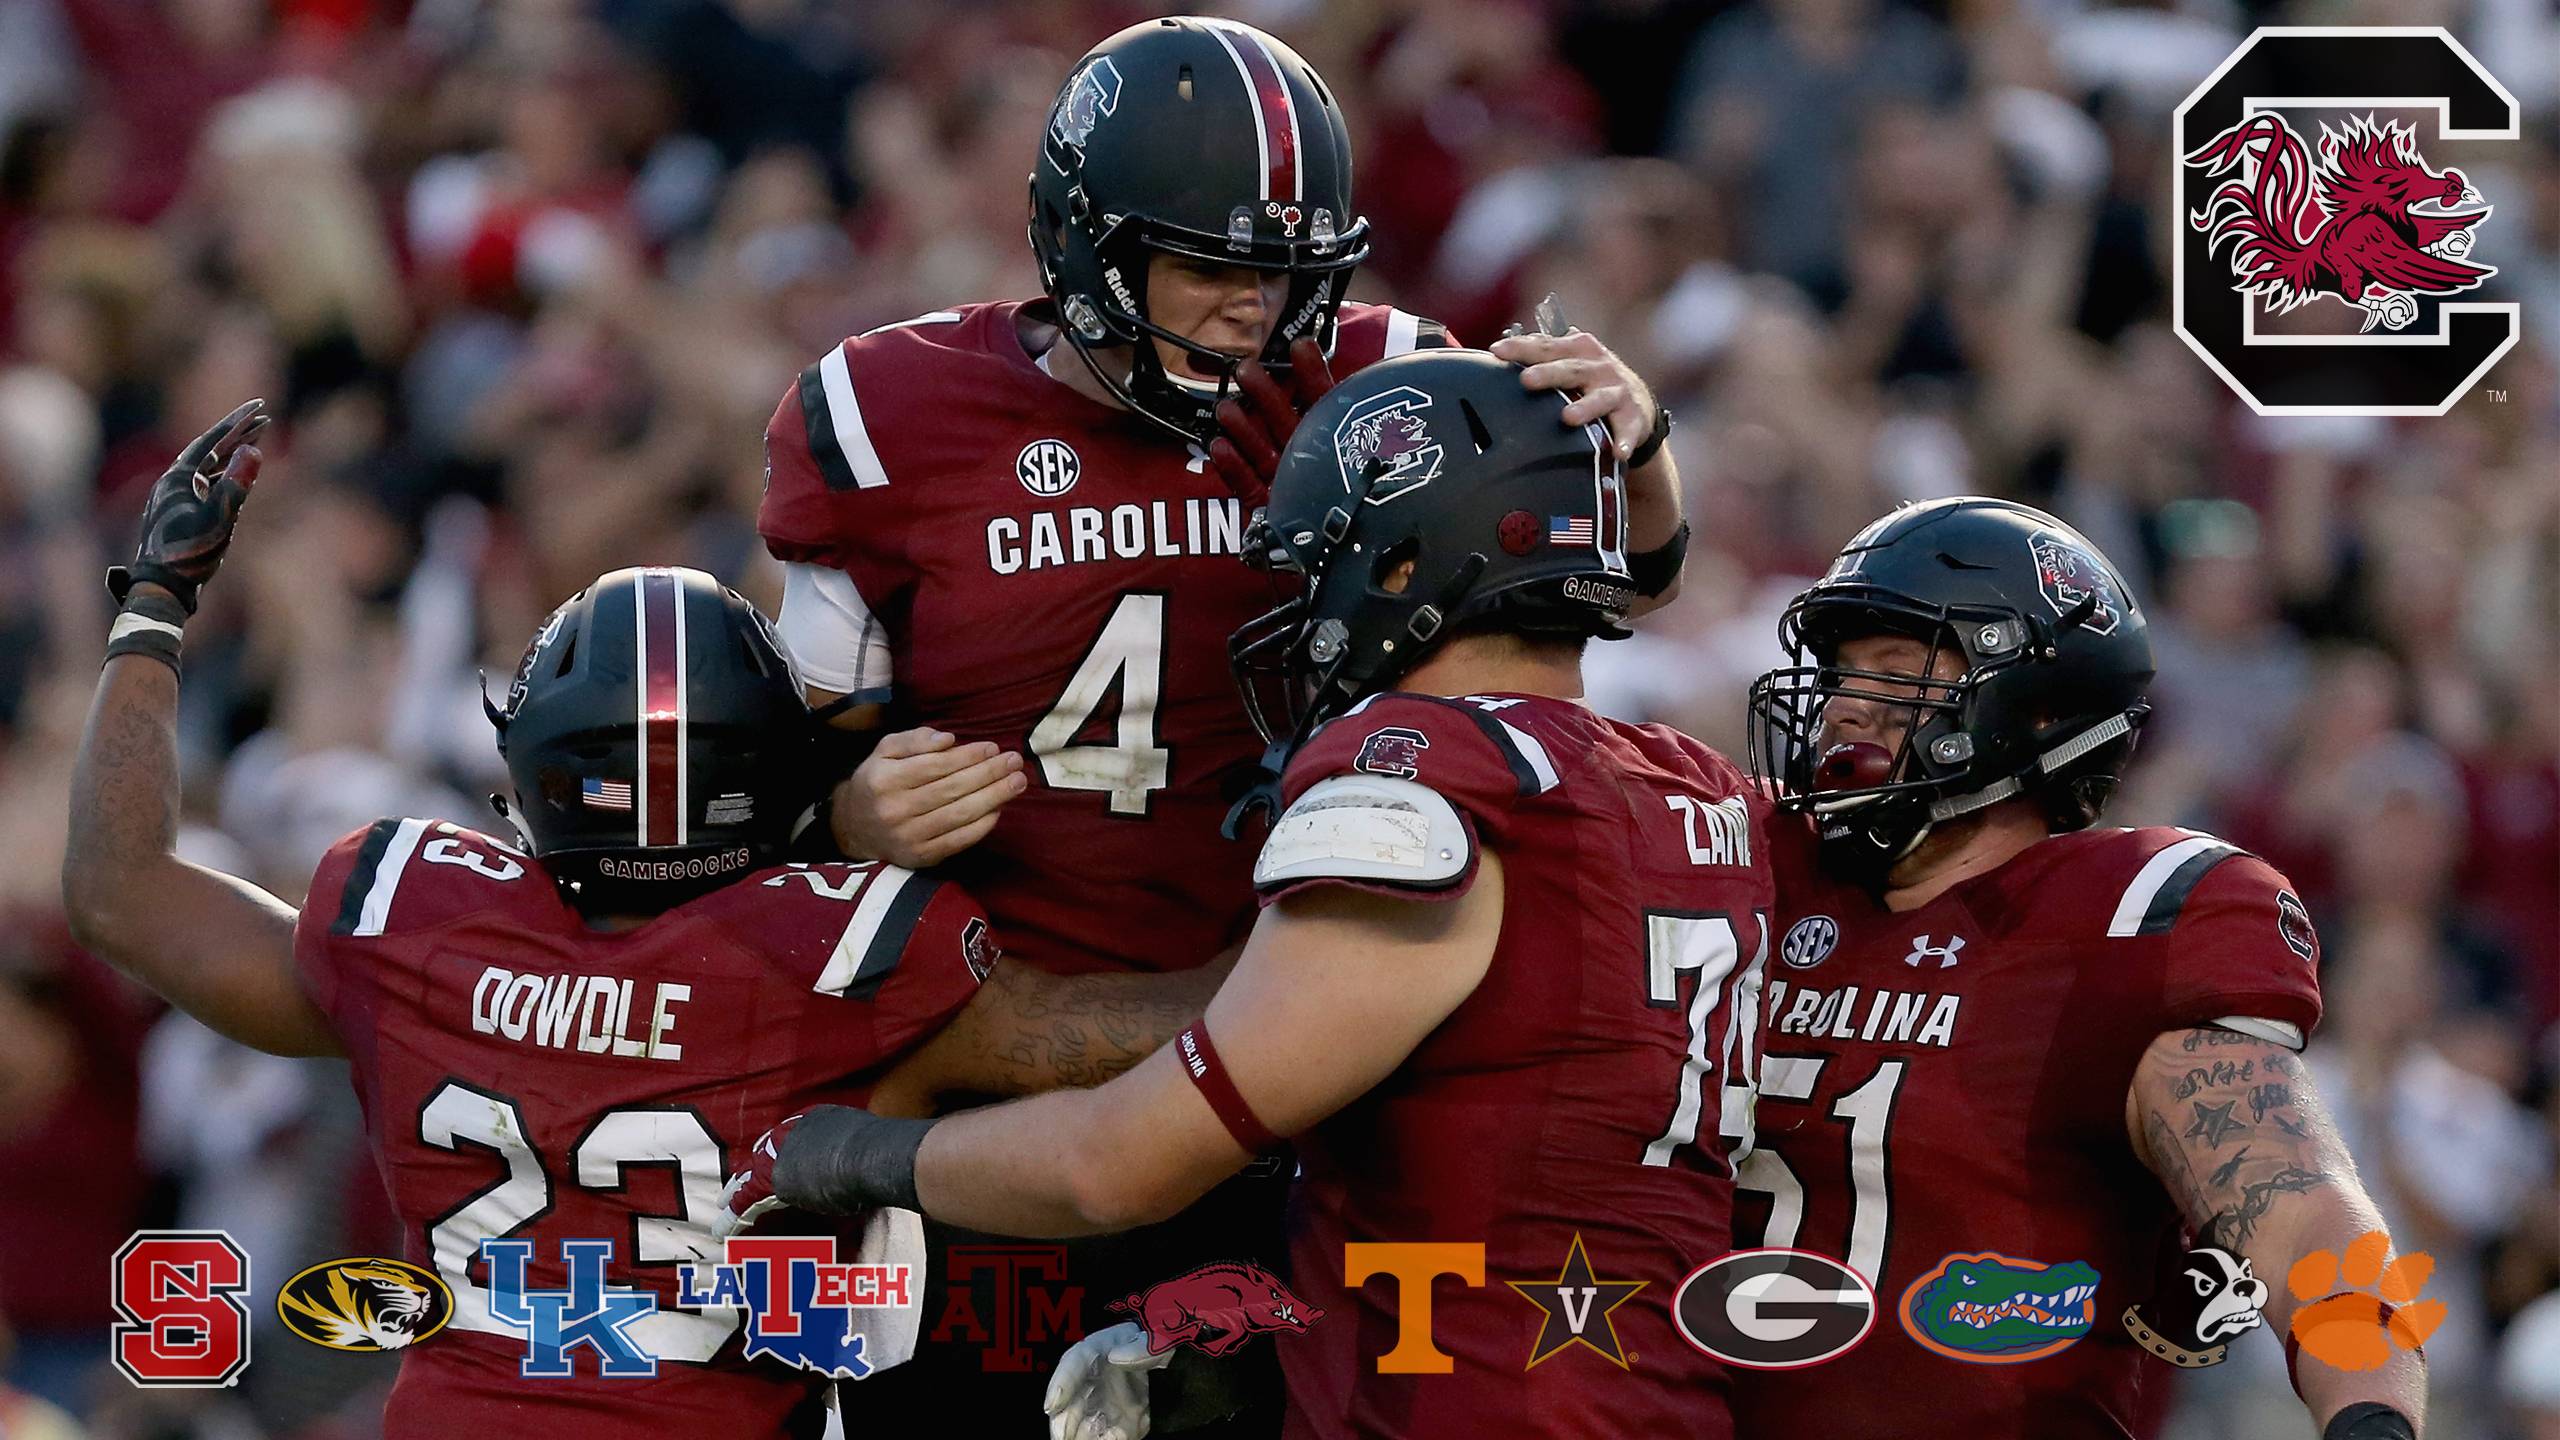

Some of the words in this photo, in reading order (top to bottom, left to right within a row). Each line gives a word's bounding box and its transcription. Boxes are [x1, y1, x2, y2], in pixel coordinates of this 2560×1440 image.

[1019, 442, 1076, 494] SEC
[987, 498, 1242, 575] CAROLIN
[1029, 594, 1168, 814] 4
[600, 848, 750, 881] GAMECOCKS
[1665, 794, 1752, 868] ZAN
[1784, 917, 1837, 966] SEC
[472, 966, 692, 1061] DOWDLE
[421, 1083, 740, 1363] 23
